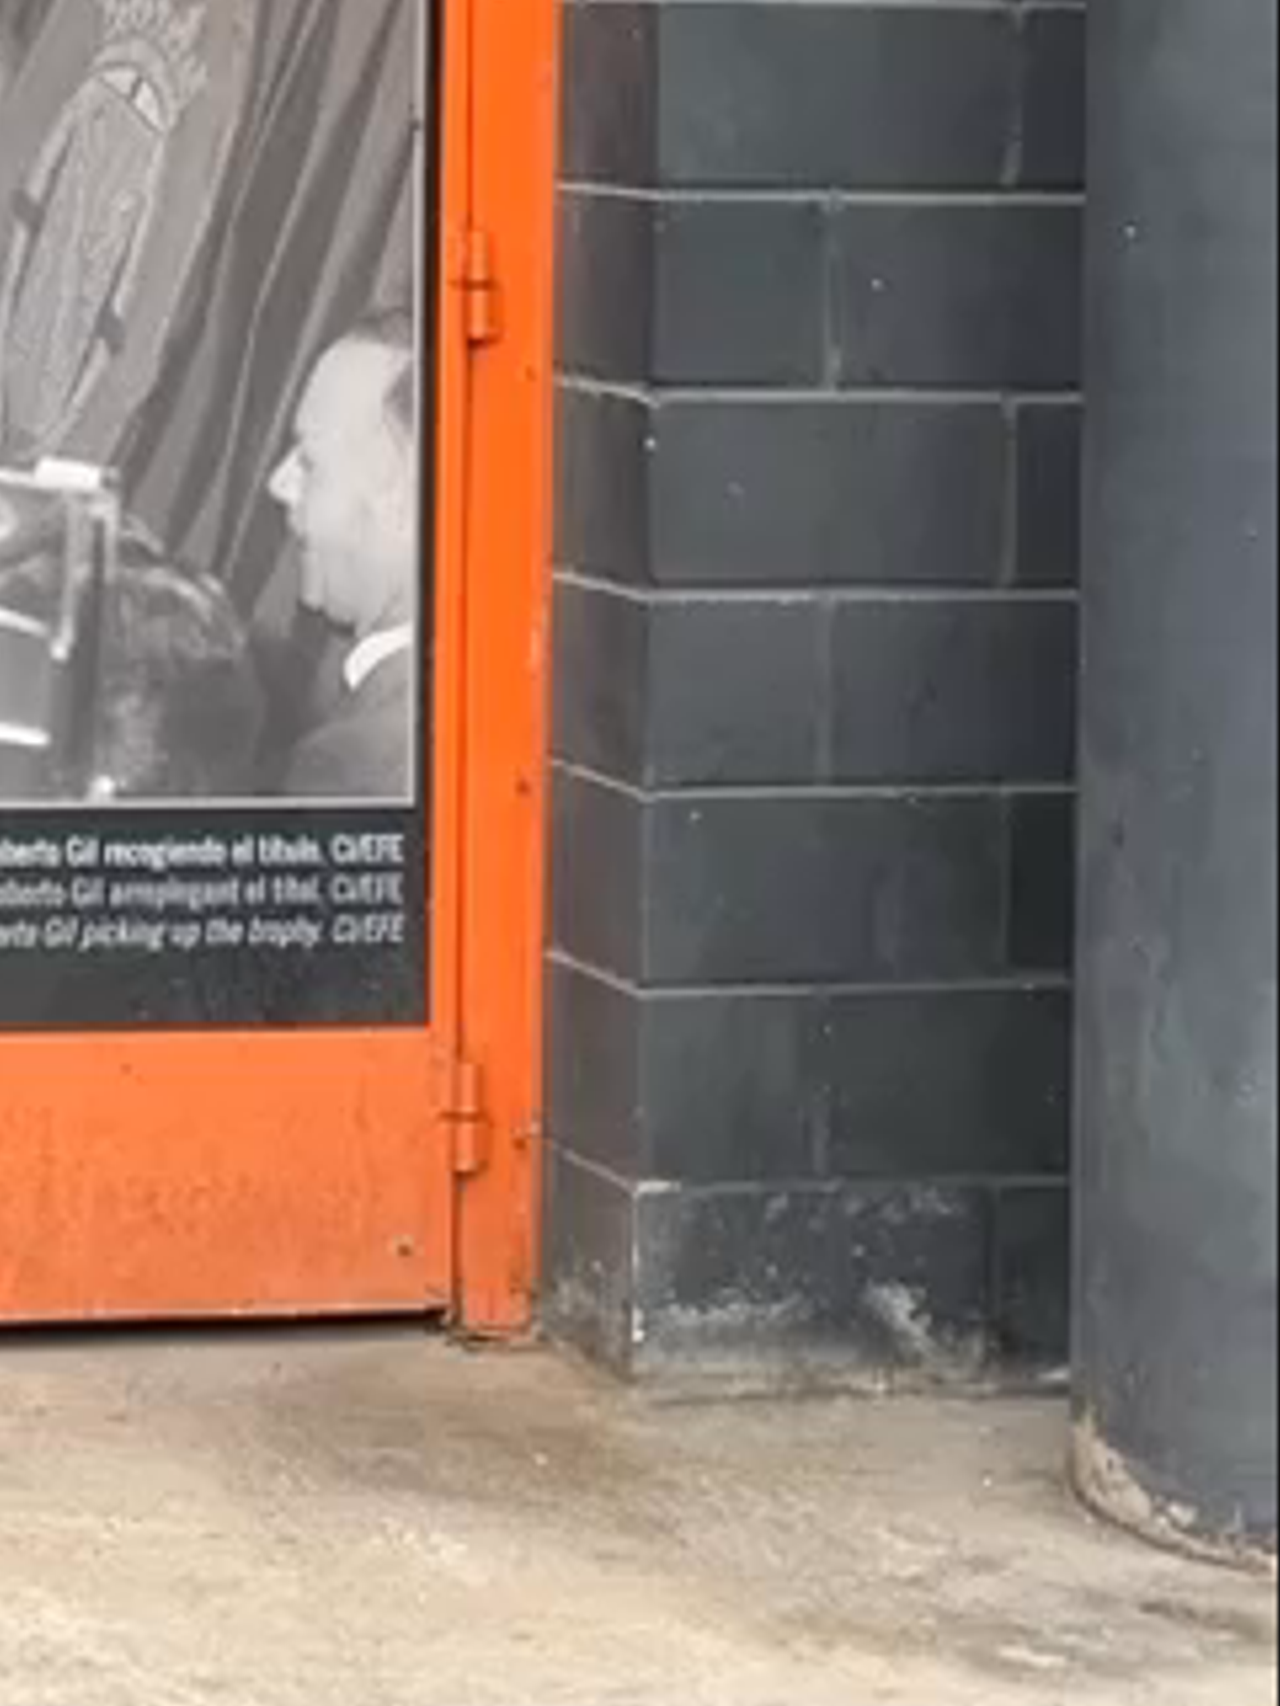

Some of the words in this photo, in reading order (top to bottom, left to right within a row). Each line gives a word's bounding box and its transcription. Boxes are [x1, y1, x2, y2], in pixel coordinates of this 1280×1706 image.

[66, 835, 98, 865] Gil
[103, 835, 226, 870] recogiendo
[232, 835, 255, 864] el
[70, 876, 104, 905] Gil
[244, 874, 266, 903] el
[42, 918, 79, 947] Gil
[78, 918, 166, 950] picking
[169, 921, 201, 949] up
[204, 917, 243, 944] the
